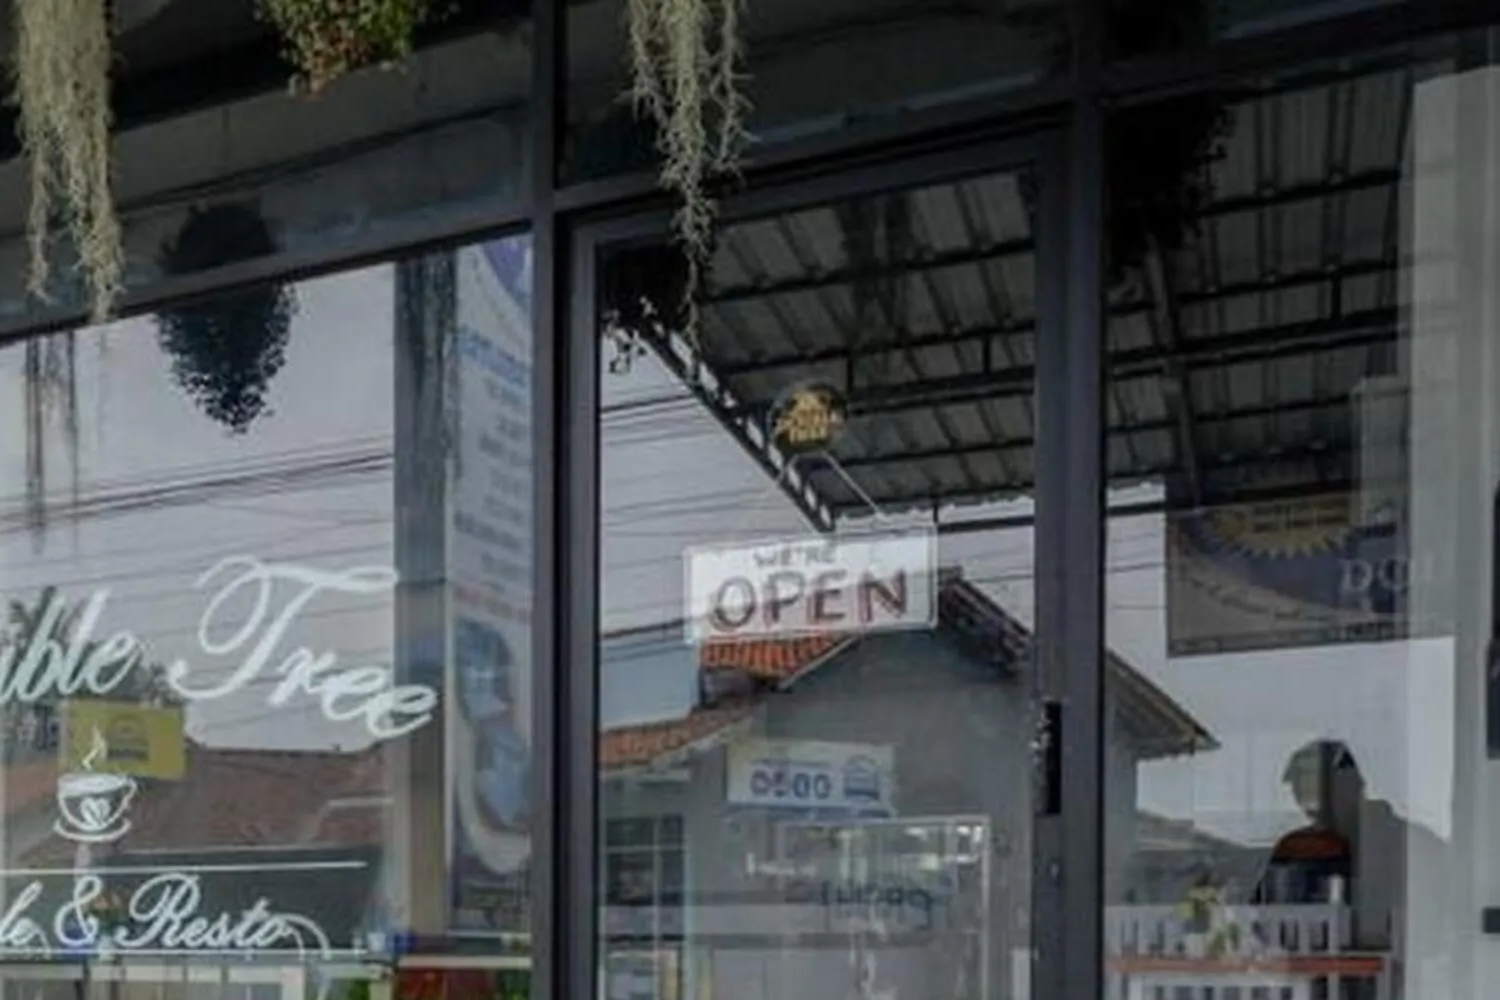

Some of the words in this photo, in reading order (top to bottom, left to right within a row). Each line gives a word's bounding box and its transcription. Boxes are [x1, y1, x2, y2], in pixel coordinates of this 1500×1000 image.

[707, 568, 907, 632] OPEN
[168, 555, 437, 737] Tree
[54, 875, 102, 948] &
[114, 873, 306, 962] Resto
